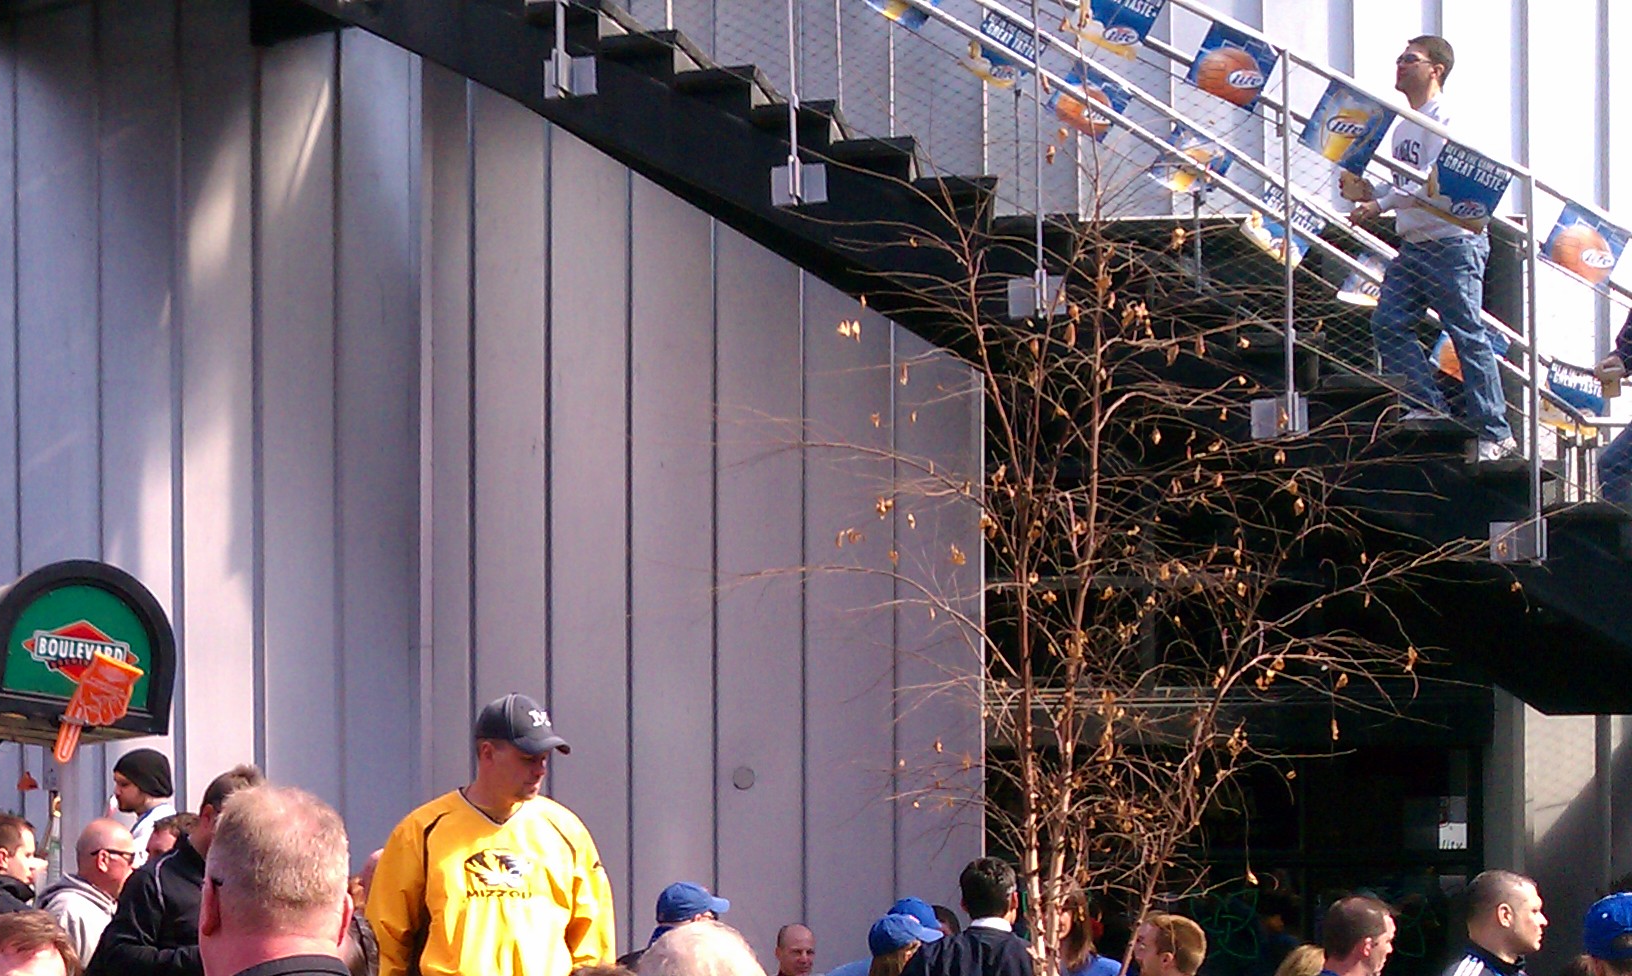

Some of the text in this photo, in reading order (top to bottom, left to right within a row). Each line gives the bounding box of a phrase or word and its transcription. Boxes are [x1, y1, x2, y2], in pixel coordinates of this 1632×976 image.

[986, 23, 1014, 45] GREAT
[1230, 71, 1263, 87] Lite
[1332, 117, 1365, 136] Lite
[1442, 155, 1504, 191] GREAT TASTE
[466, 889, 533, 900] MIZZOU
